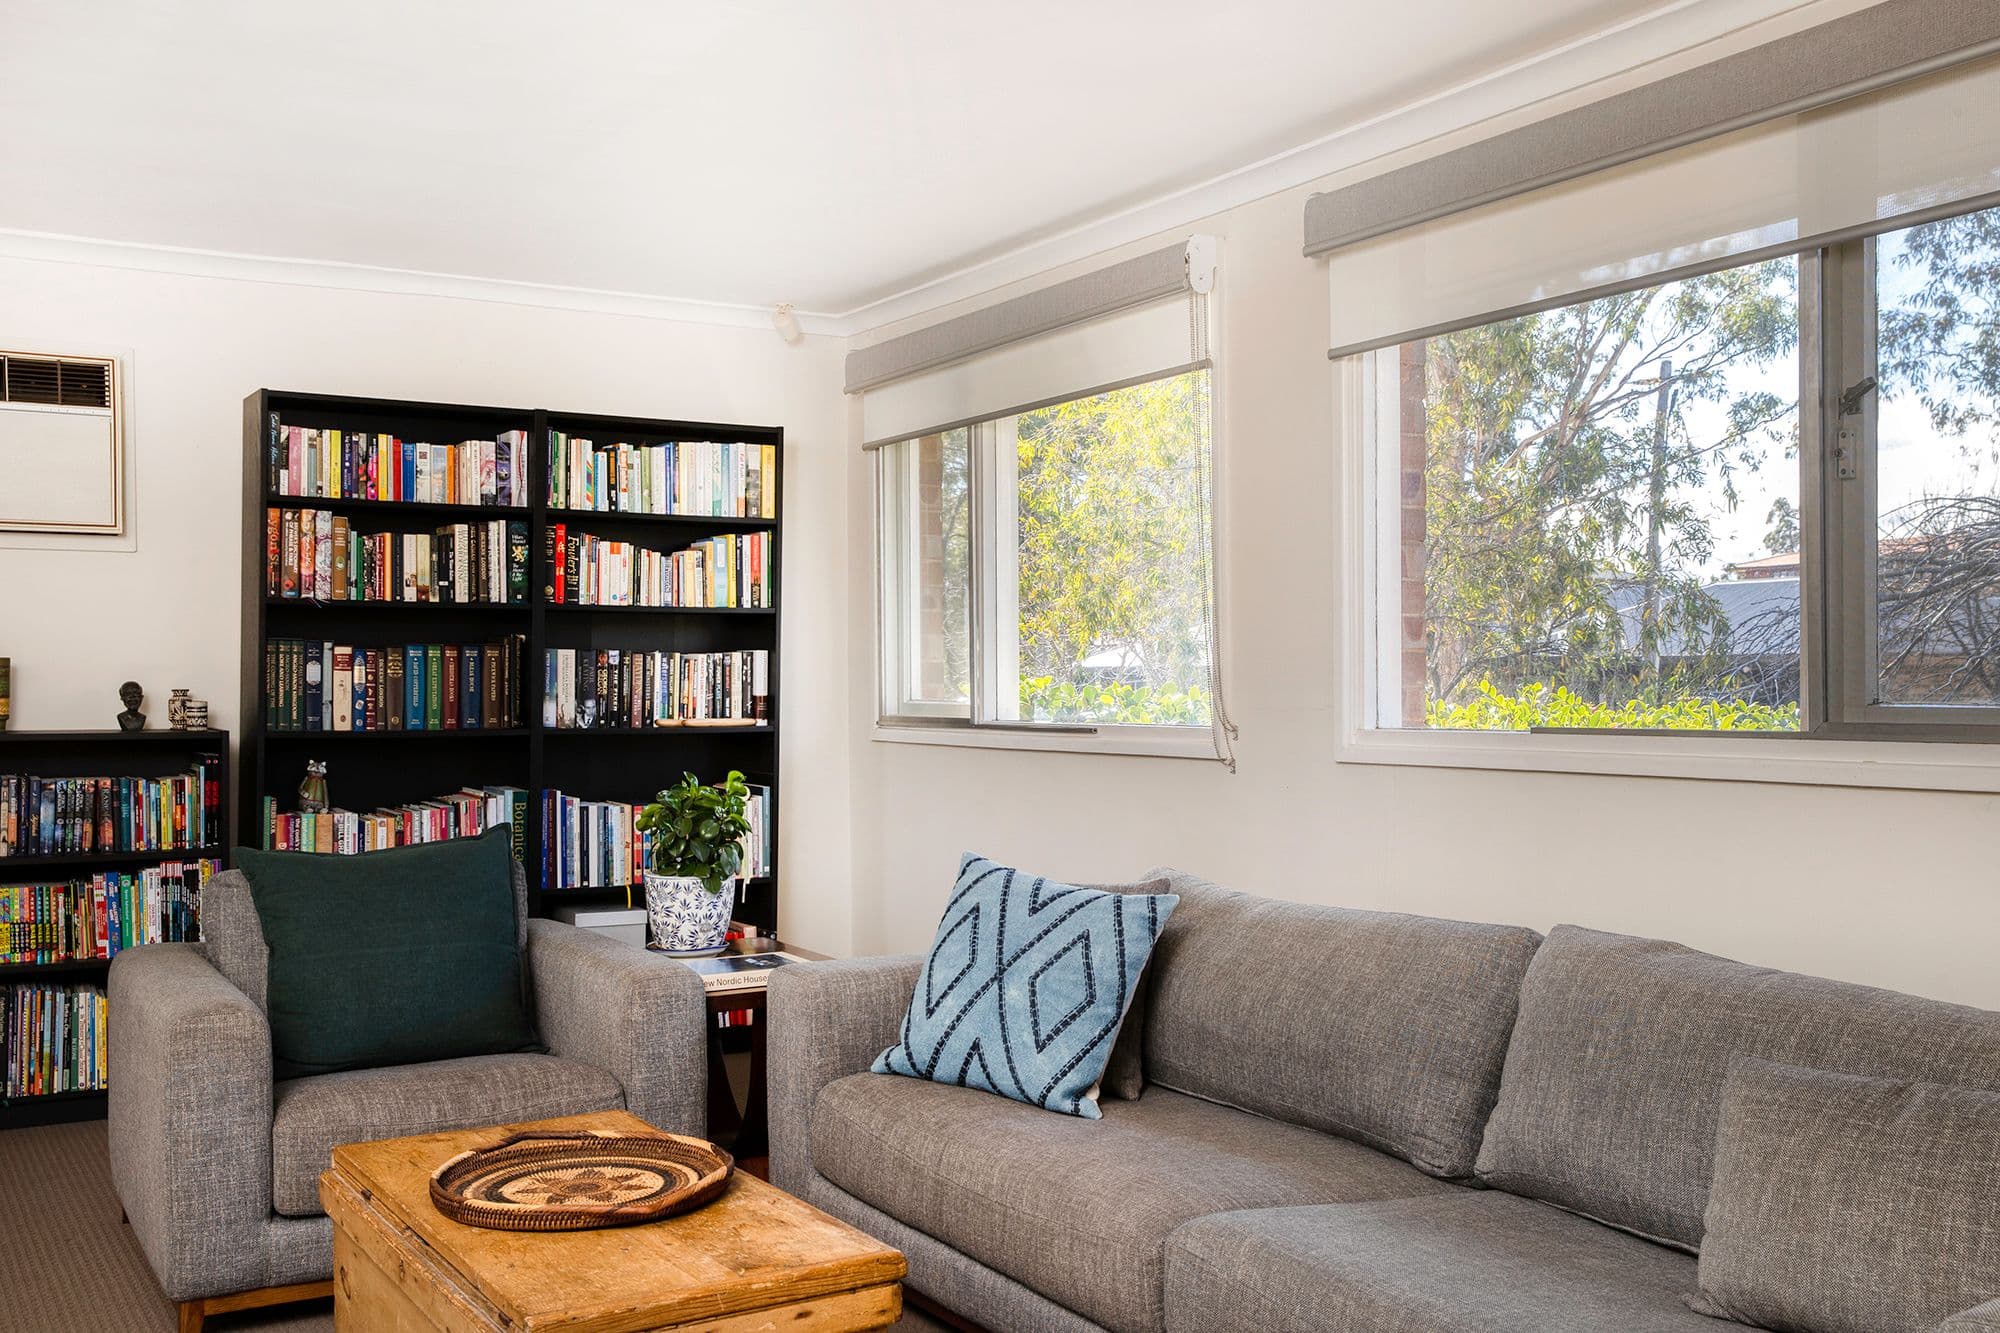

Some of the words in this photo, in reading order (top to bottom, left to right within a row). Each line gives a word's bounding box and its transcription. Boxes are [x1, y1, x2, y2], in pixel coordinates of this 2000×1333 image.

[268, 511, 279, 550] Lygon
[567, 536, 579, 574] Fowler's
[514, 801, 527, 862] Botanica
[703, 980, 715, 988] ew
[716, 976, 742, 986] Nordic
